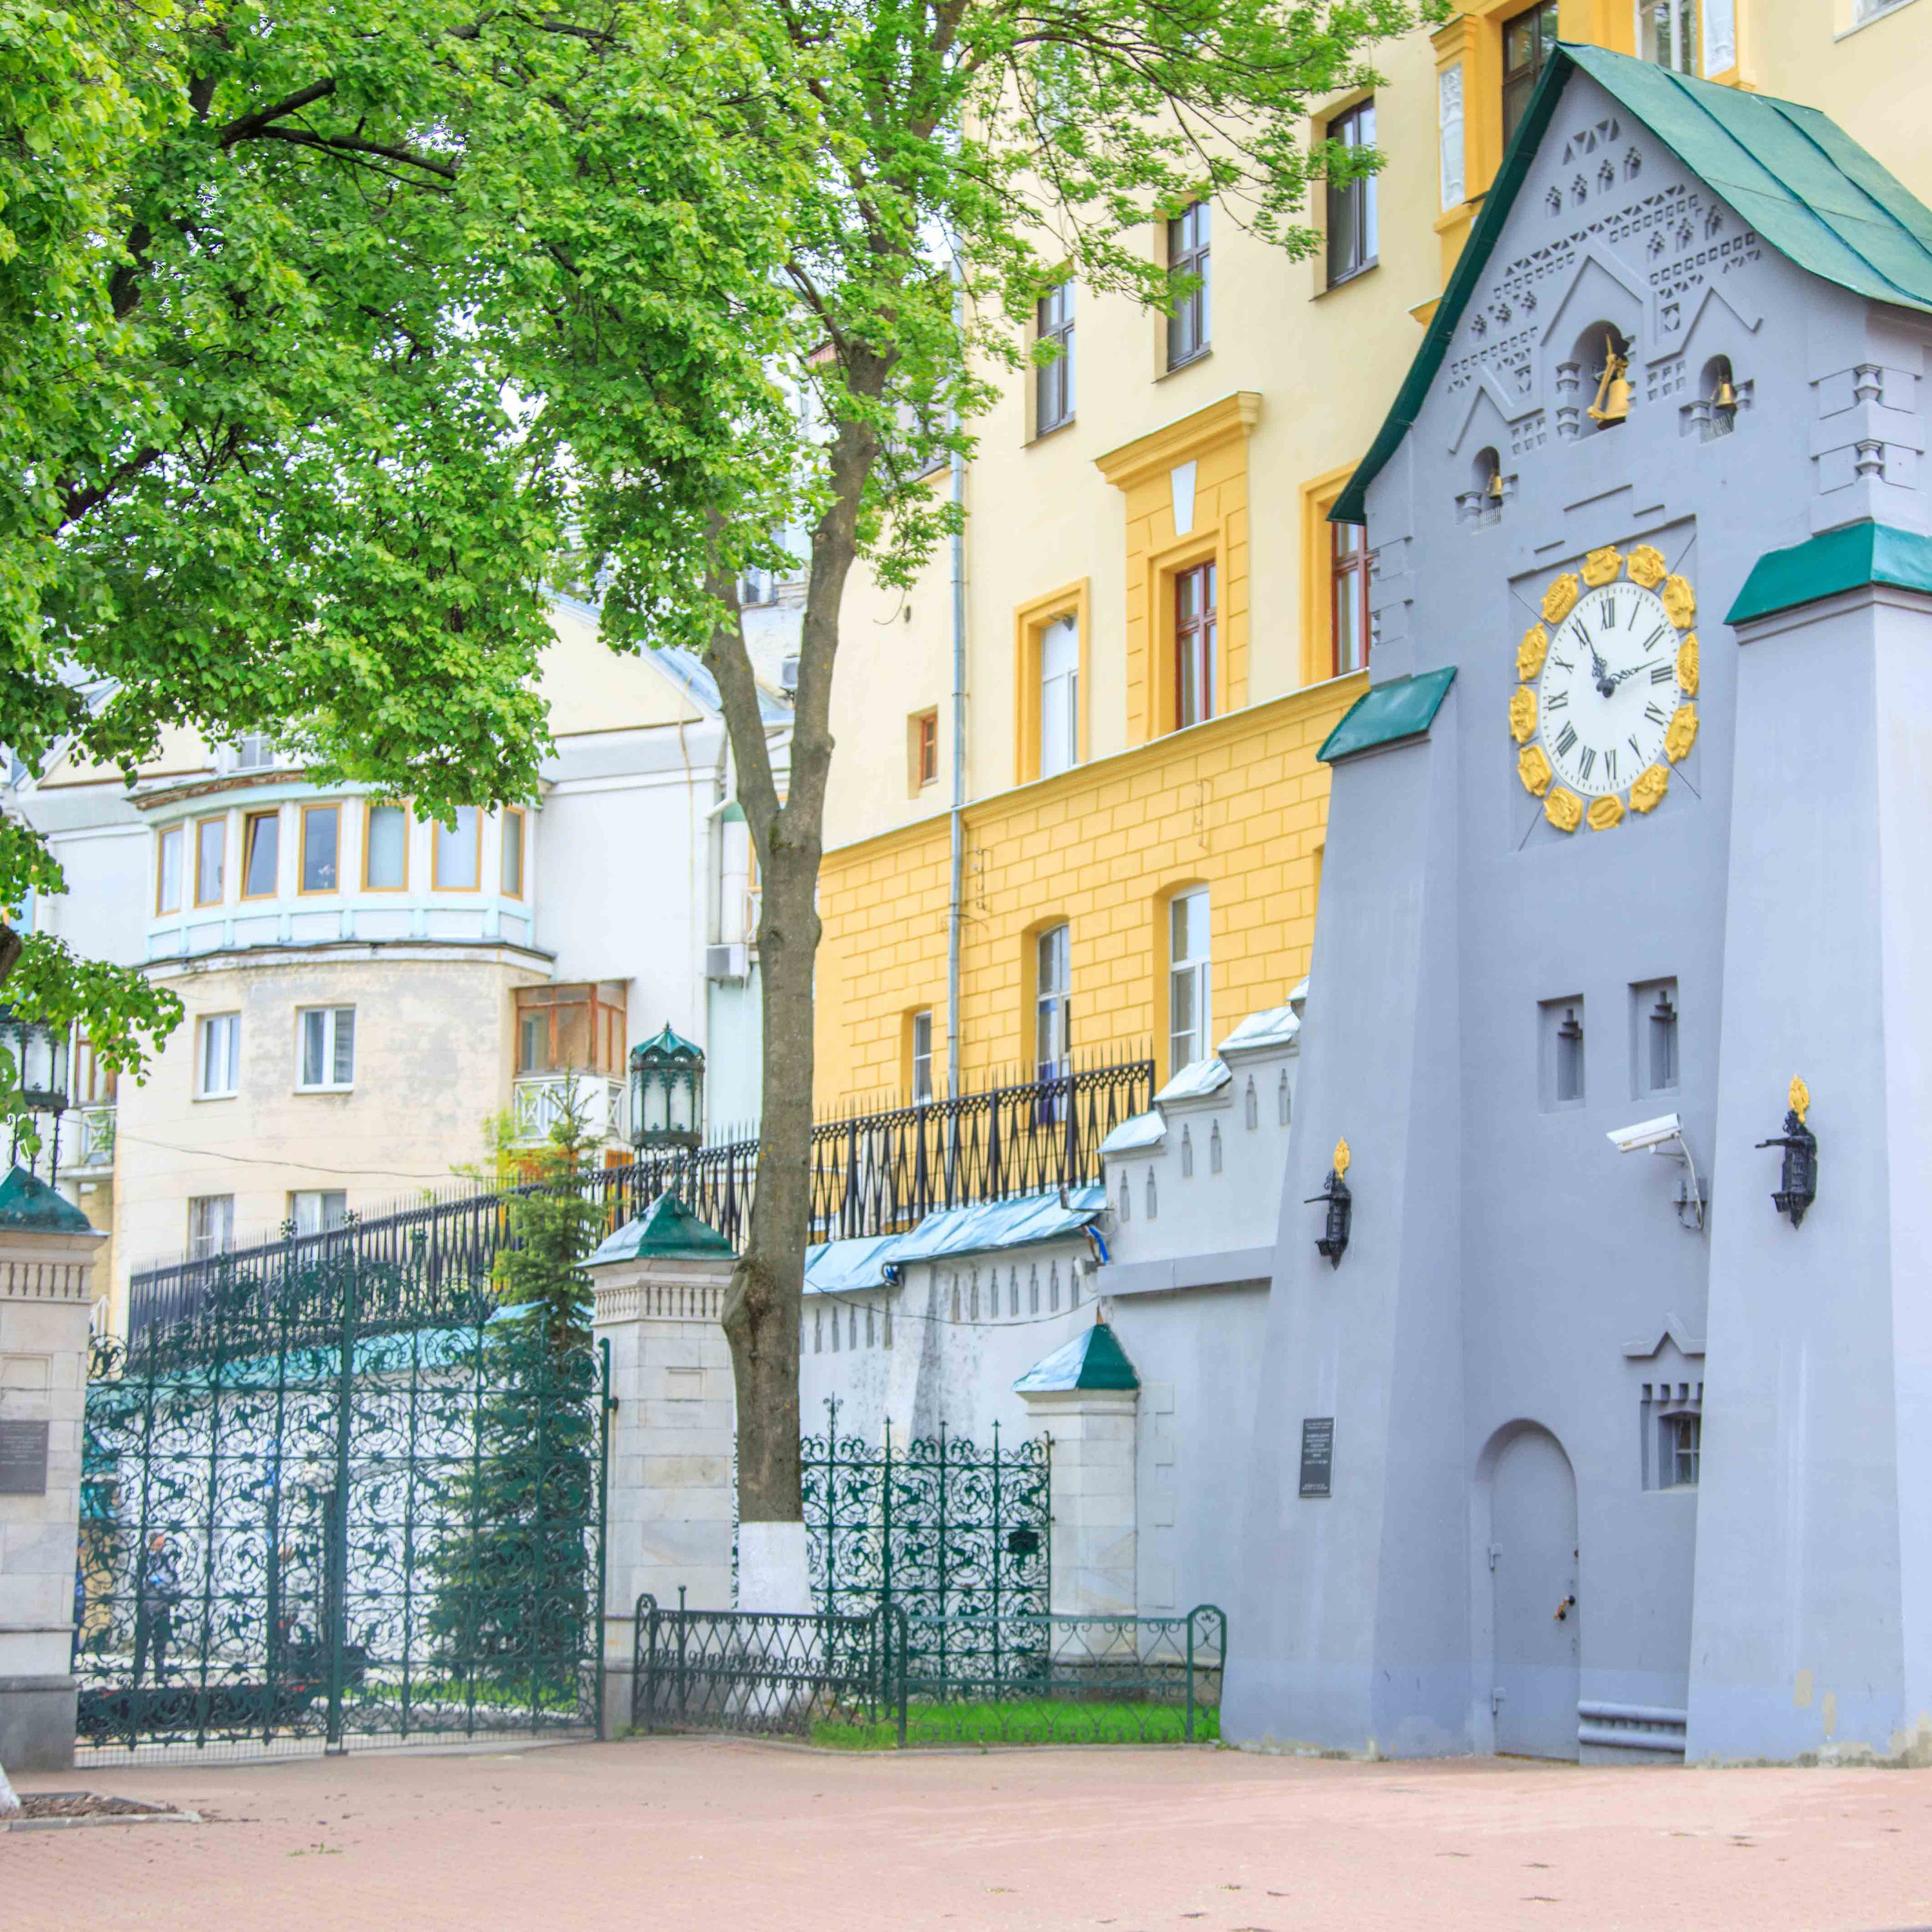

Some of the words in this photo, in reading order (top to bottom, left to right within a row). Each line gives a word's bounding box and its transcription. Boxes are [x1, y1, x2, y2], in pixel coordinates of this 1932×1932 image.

[1600, 597, 1615, 631] XII
[1628, 601, 1640, 631] I
[1643, 624, 1665, 652] II
[1555, 655, 1574, 674] X
[1651, 664, 1673, 685] III
[1548, 690, 1567, 711] IX
[1644, 700, 1666, 726] IV
[1555, 720, 1578, 758] VIII
[1628, 734, 1642, 760] V
[1578, 745, 1597, 780] VII
[1604, 749, 1617, 782] VI
